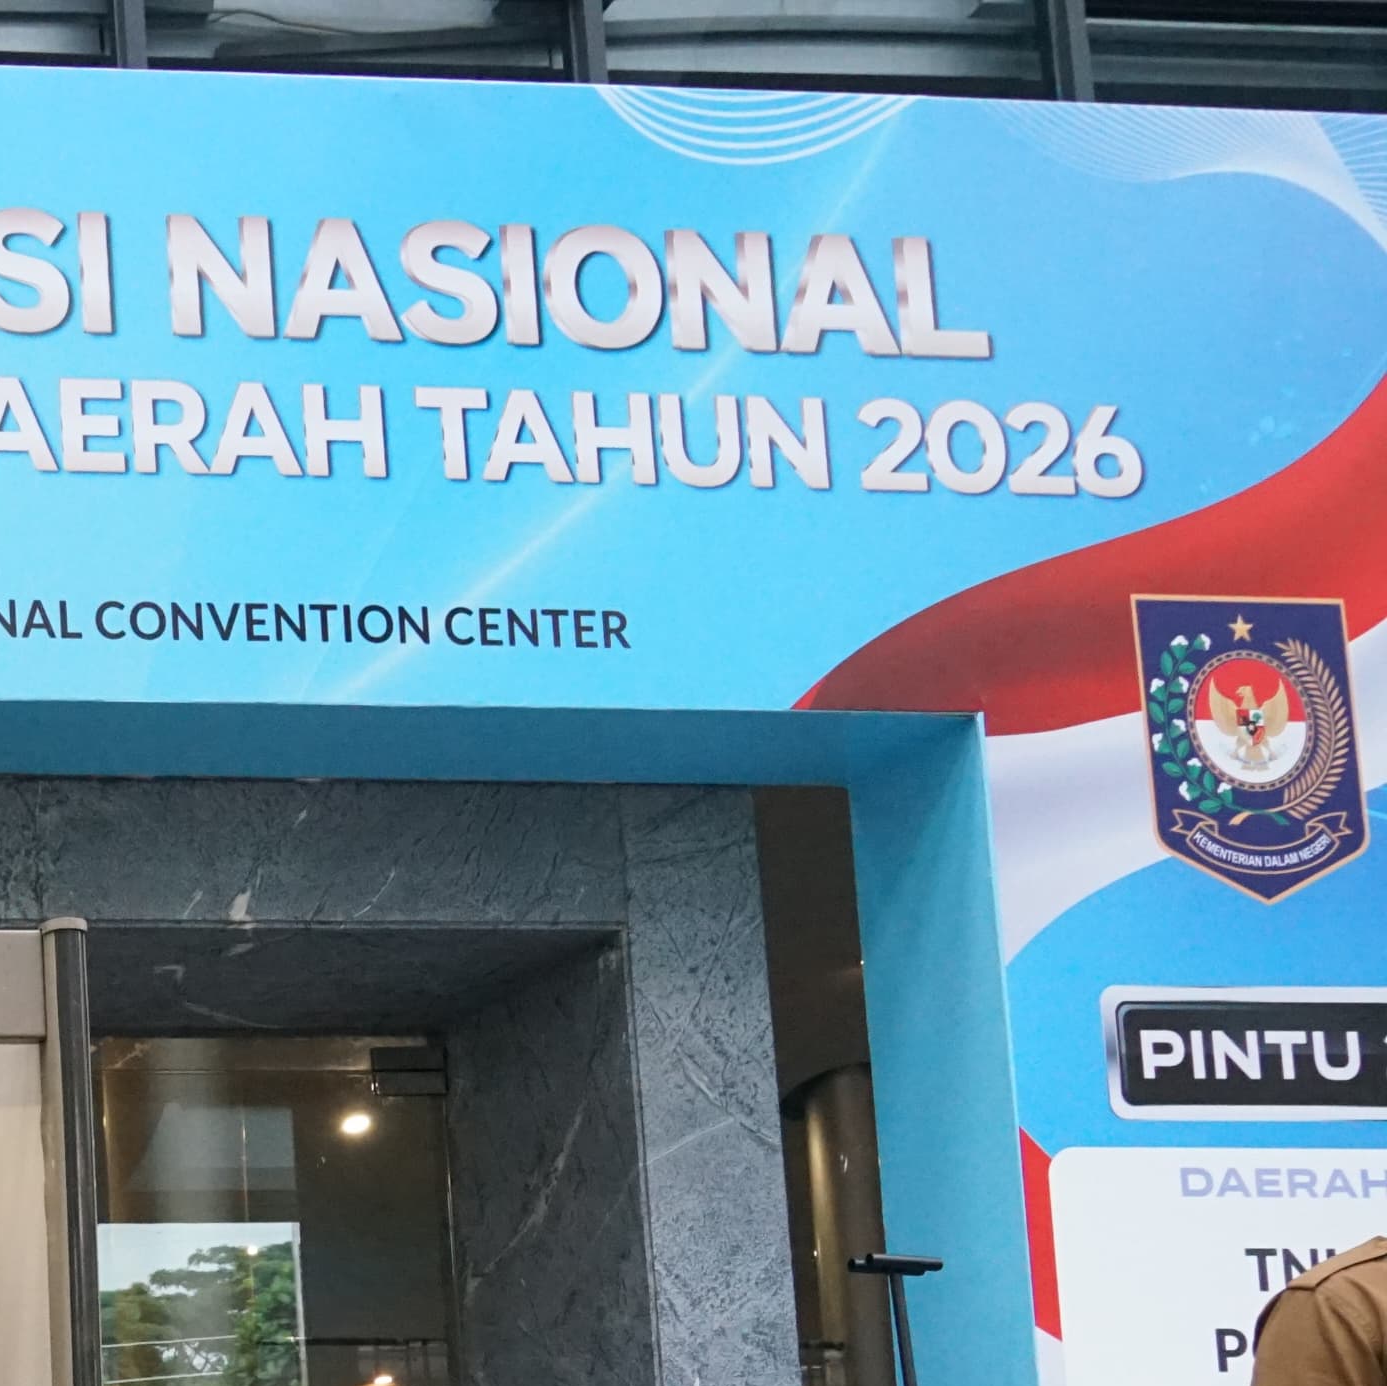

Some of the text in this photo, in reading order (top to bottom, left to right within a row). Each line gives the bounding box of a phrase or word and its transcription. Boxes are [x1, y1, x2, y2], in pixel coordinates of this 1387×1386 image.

[166, 214, 994, 360] NASIONAL
[414, 385, 830, 490] TAHUN
[857, 397, 1144, 499] 2026
[94, 599, 431, 646] CONVENTION
[443, 606, 631, 650] CENTER
[1193, 831, 1263, 867] KEMENTERIAN
[1264, 850, 1300, 867] DALAM
[1138, 1029, 1362, 1081] PINTU
[1179, 1167, 1387, 1199] DAERAH
[1244, 1248, 1336, 1292] TN
